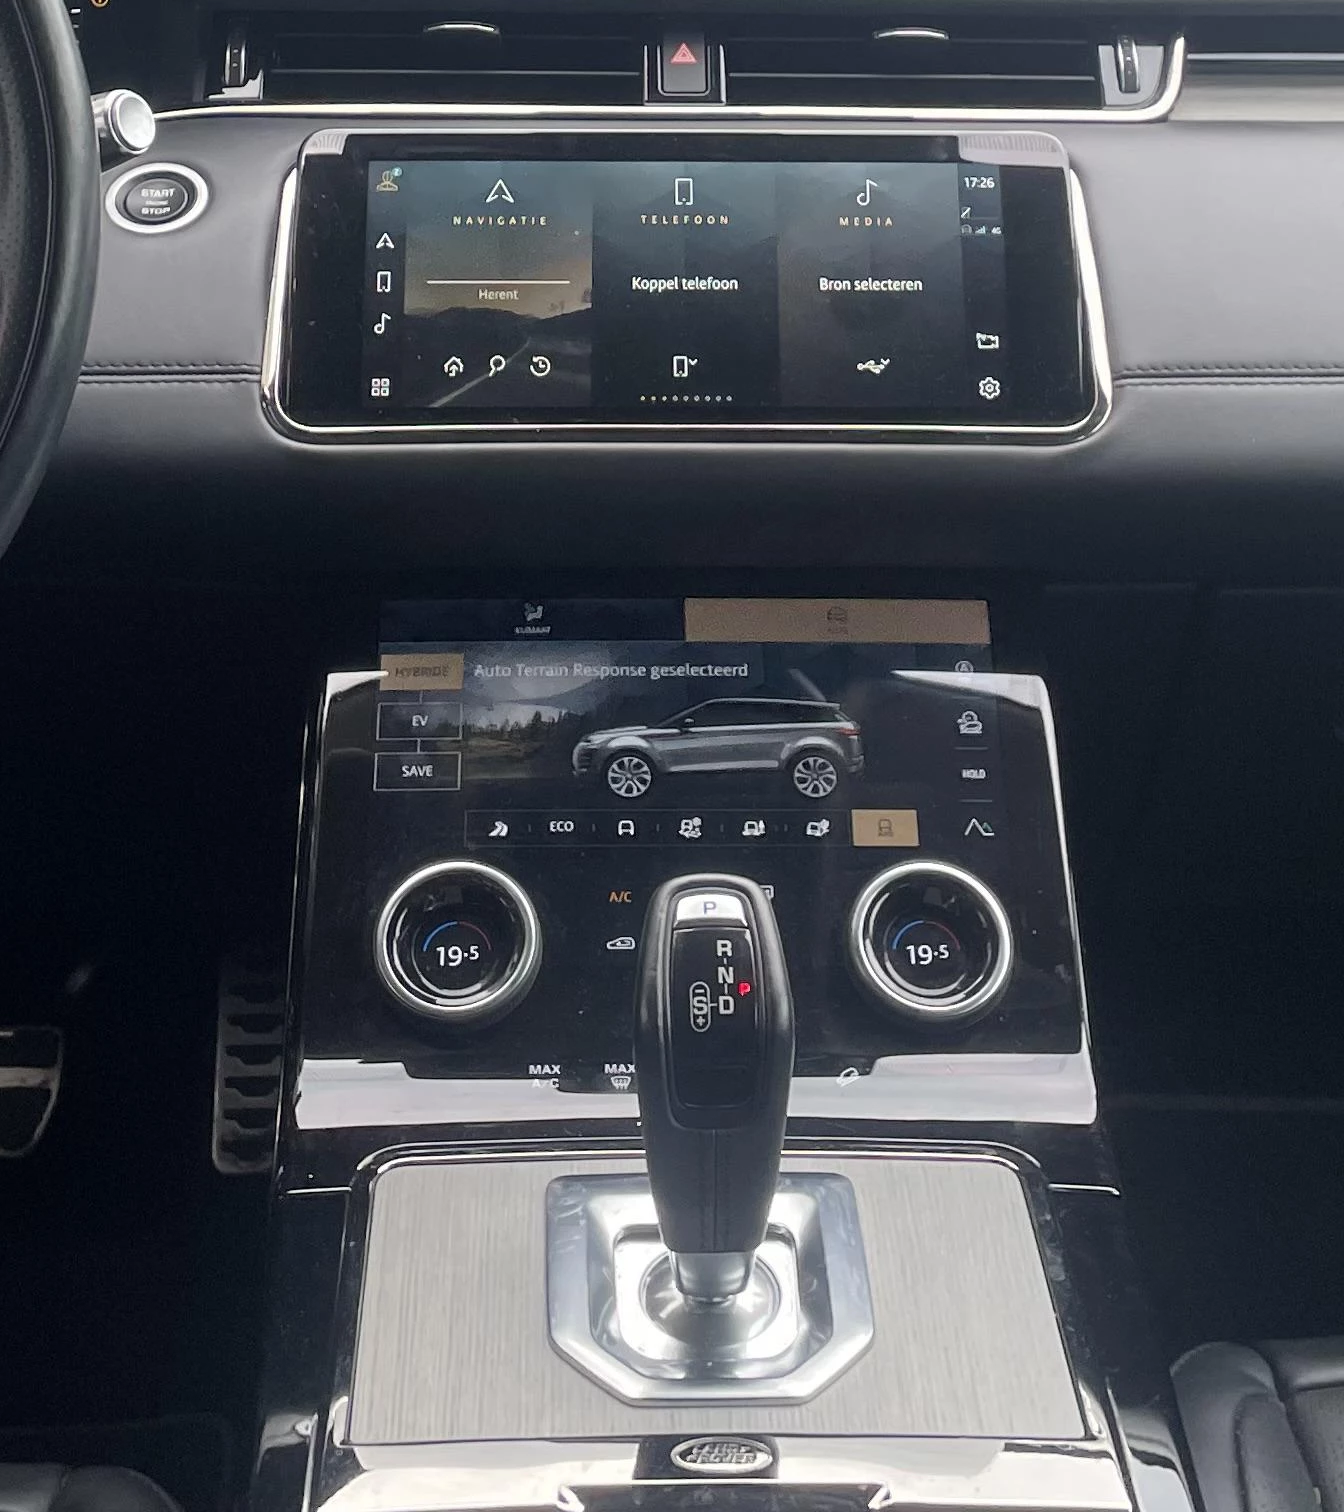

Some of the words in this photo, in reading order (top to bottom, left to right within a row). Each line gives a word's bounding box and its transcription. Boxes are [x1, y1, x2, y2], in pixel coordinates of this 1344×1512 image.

[963, 176, 996, 190] 17:26
[141, 187, 176, 198] START
[141, 206, 171, 215] STOP
[452, 215, 548, 226] NAVIGATIE
[640, 214, 730, 226] TELEFOON
[839, 216, 895, 227] MEDIA
[631, 276, 679, 294] Koppel
[681, 275, 739, 291] telefoon
[819, 277, 851, 292] Bron
[853, 277, 923, 292] selecteren
[478, 289, 520, 302] Herent
[473, 662, 512, 678] Auto
[515, 662, 569, 678] Terrain
[573, 662, 647, 681] Response
[650, 662, 749, 681] geselecteerd
[411, 714, 429, 727] EV
[401, 764, 434, 778] SAVE
[549, 820, 575, 833] ECO
[609, 890, 632, 903] A/C
[703, 901, 718, 914] P
[716, 939, 732, 957] R
[717, 966, 734, 984] N
[693, 996, 708, 1015] S
[718, 996, 734, 1015] D
[528, 1064, 561, 1075] MAX
[604, 1063, 636, 1074] MAX
